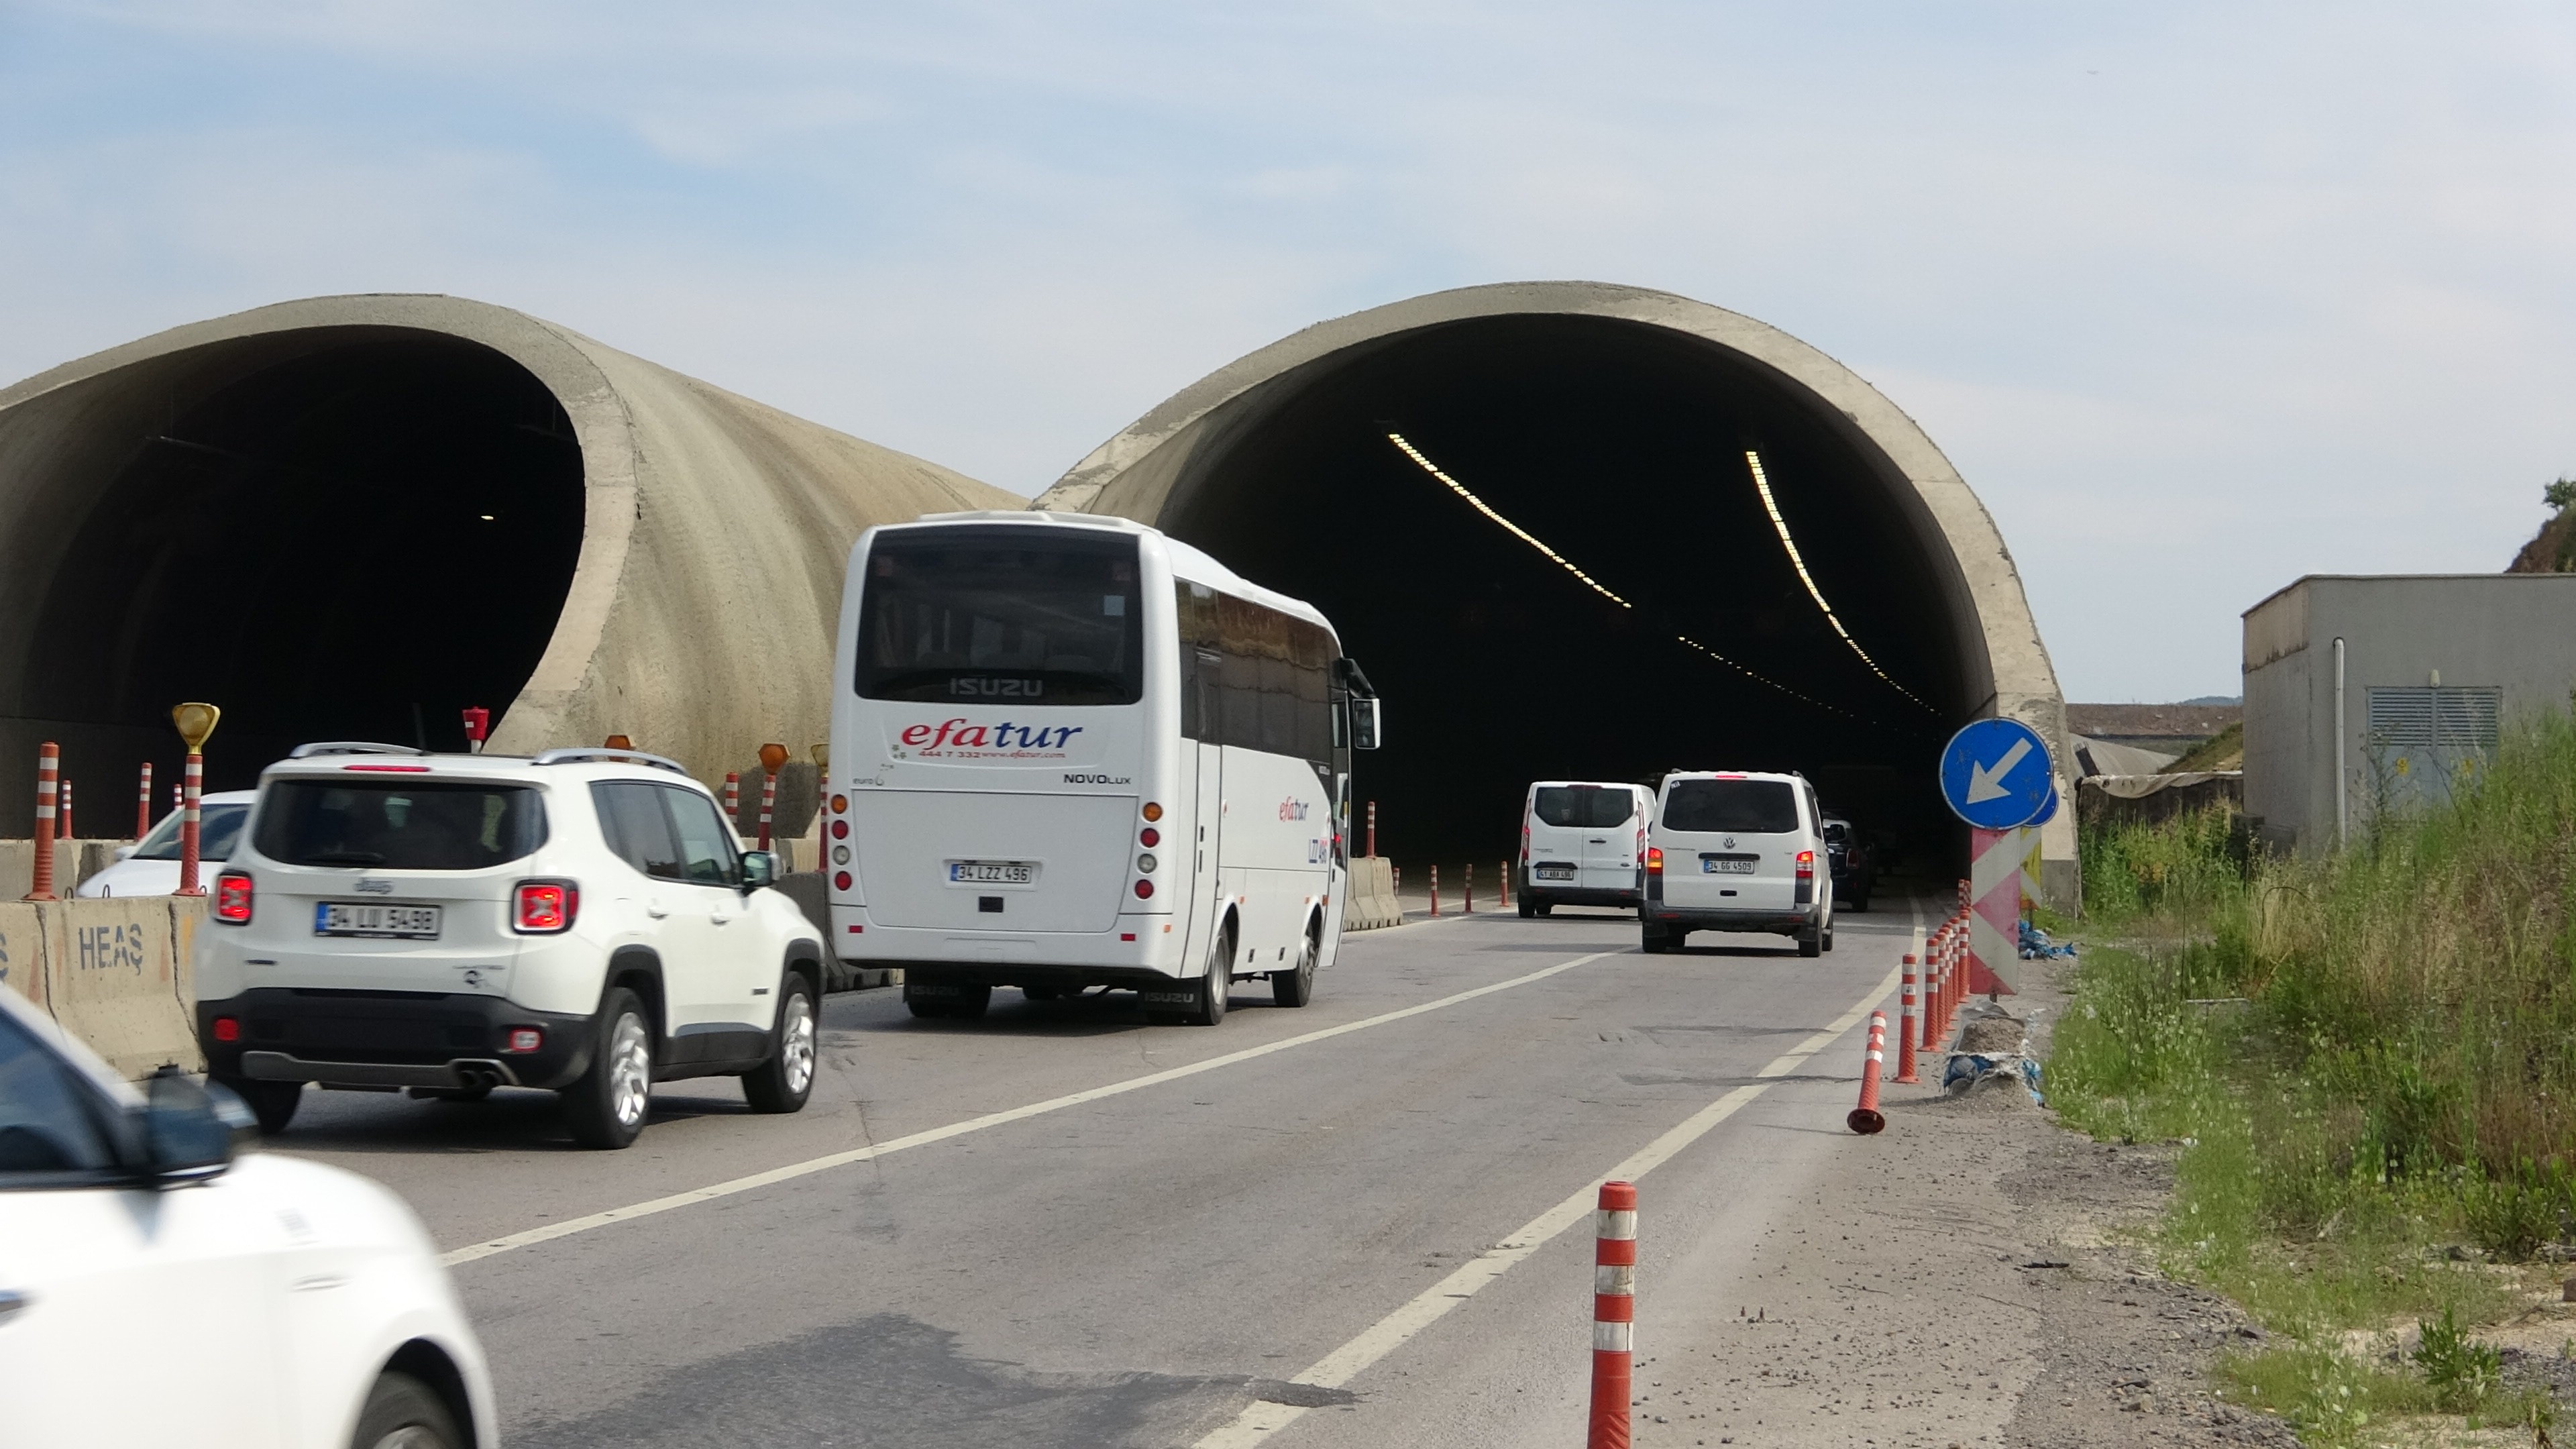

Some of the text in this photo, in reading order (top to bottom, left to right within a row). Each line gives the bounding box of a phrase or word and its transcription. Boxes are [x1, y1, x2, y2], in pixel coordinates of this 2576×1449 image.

[950, 678, 1043, 696] ISUZU
[901, 718, 1083, 751] efatur
[958, 751, 981, 759] 332
[1279, 796, 1309, 822] efatur
[959, 866, 1028, 881] 34 LZZ 496
[1709, 861, 1717, 869] 34
[1733, 862, 1752, 871] 4509
[329, 908, 350, 926] 34
[79, 923, 144, 976] HEAŞ
[1144, 993, 1194, 1003] ISUZU
